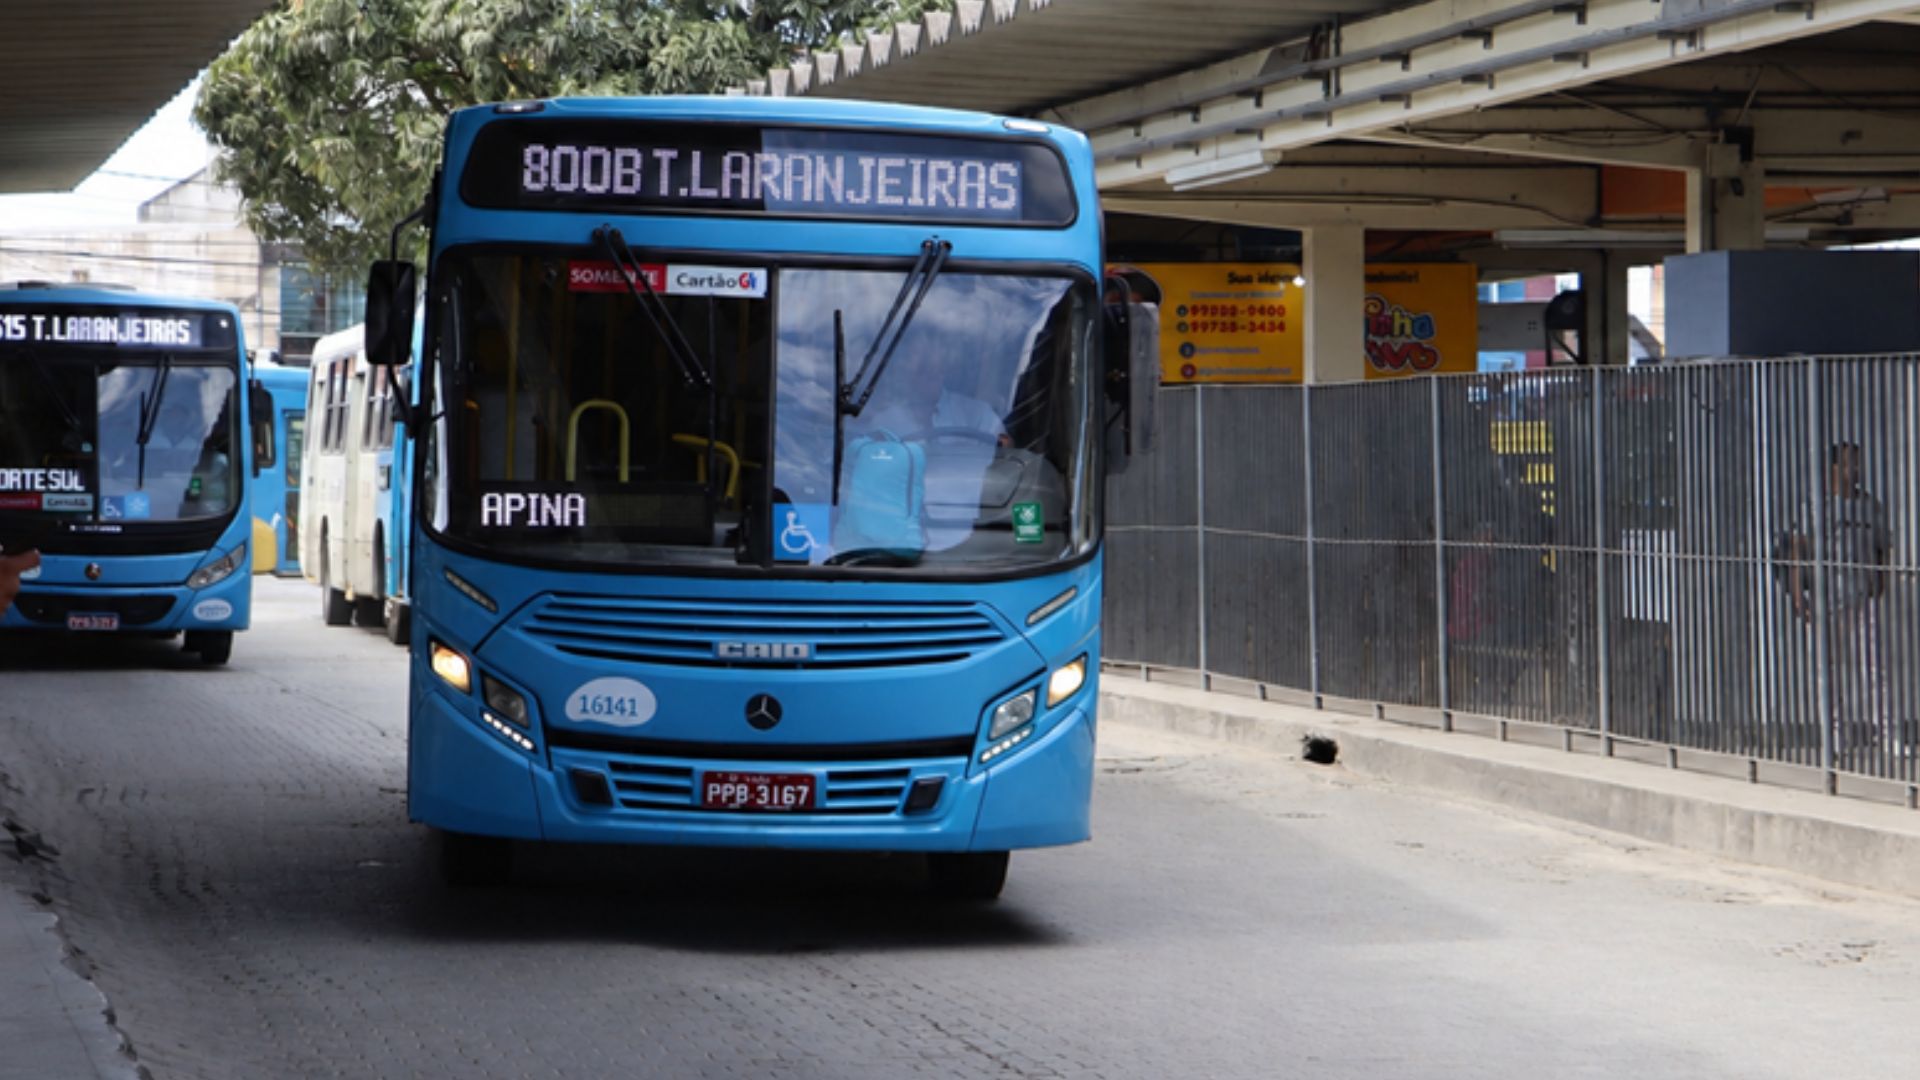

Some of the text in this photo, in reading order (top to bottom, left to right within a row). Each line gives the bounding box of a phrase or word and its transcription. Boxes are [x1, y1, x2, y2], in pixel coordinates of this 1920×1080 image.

[522, 144, 642, 194] 800B
[481, 492, 586, 526] APINA
[718, 642, 809, 658] CAIO
[579, 694, 639, 717] 16141
